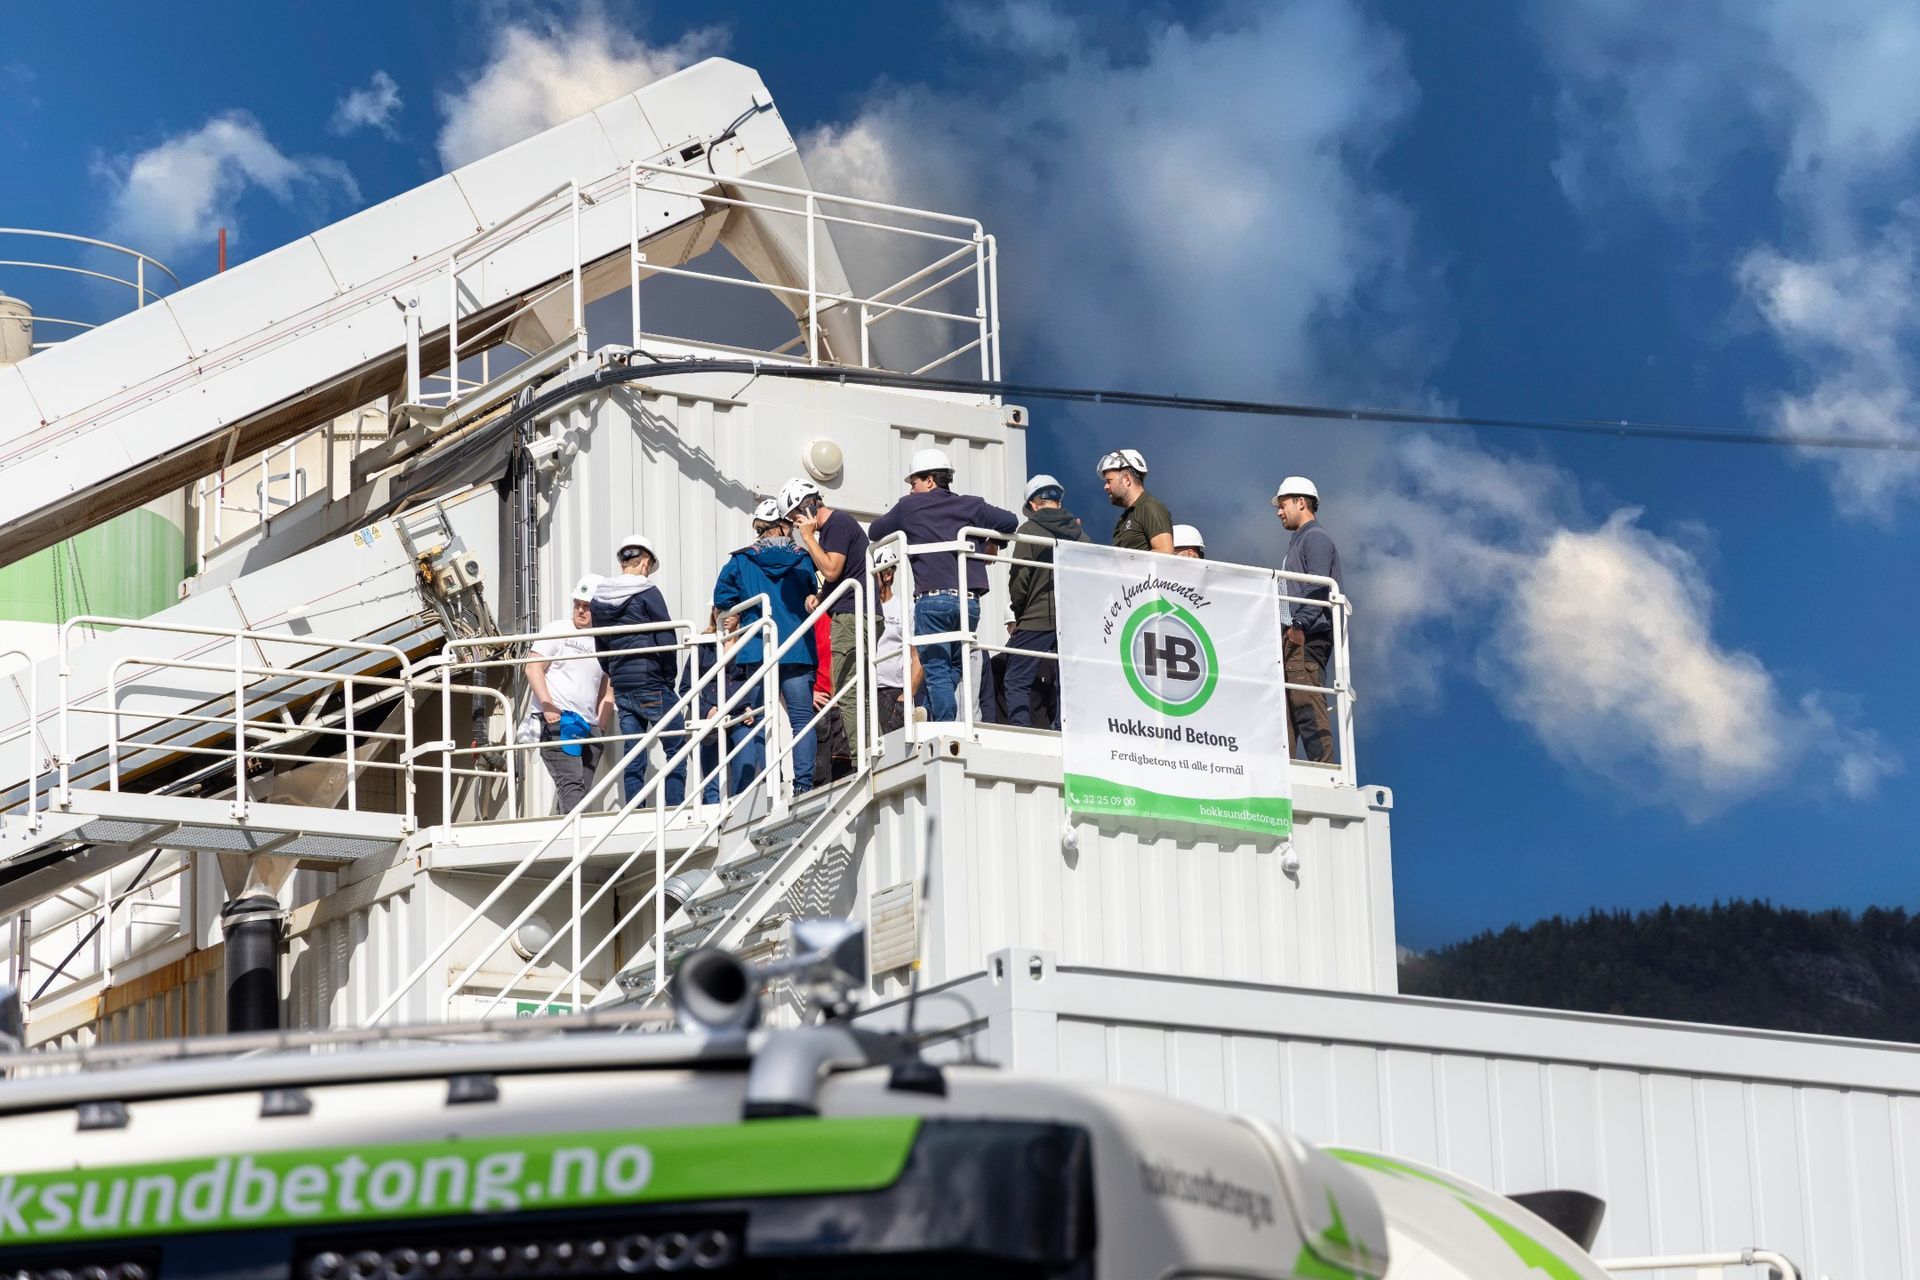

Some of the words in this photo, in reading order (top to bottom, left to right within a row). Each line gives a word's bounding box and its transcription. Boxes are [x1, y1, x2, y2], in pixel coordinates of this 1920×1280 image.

[1103, 615, 1114, 635] vi
[1110, 601, 1122, 617] er
[1121, 573, 1212, 609] fundamentet!
[1143, 631, 1201, 682] HB
[1108, 717, 1182, 742] Hokksund
[1186, 727, 1239, 752] Betong
[1110, 749, 1177, 770] Ferdigbetong
[1179, 759, 1191, 770] til
[1191, 760, 1208, 772] alle
[1210, 762, 1244, 776] formål
[1082, 794, 1095, 804] 32
[1097, 794, 1109, 805] 25
[1110, 796, 1122, 806] 09
[1123, 797, 1136, 806] 00
[1199, 804, 1290, 827] hokksundbetong.no
[0, 1144, 654, 1236] ksundbetong.no
